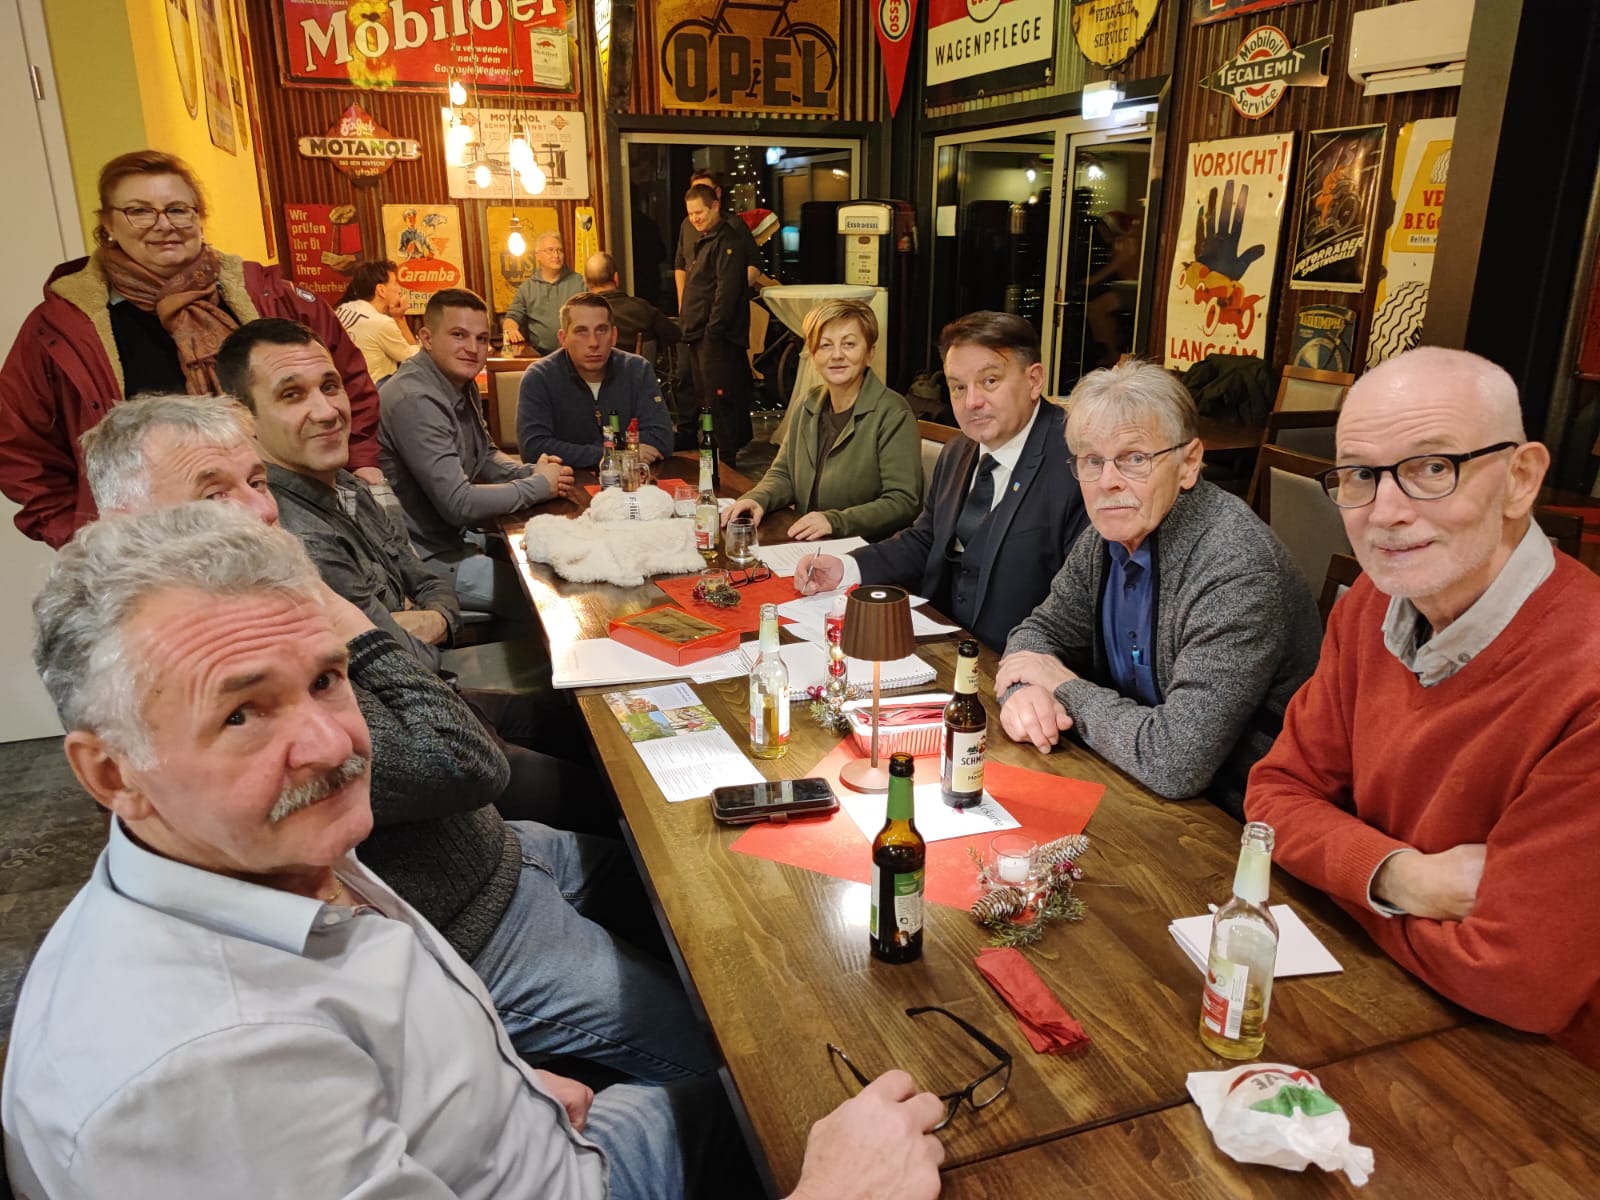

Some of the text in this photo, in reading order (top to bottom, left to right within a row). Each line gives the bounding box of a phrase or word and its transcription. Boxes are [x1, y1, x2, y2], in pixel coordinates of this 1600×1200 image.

[1095, 2, 1134, 22] VERKAUF
[935, 16, 1041, 66] WAGENPFLEGE
[1094, 27, 1129, 48] SERVICE
[1239, 30, 1285, 62] Mobiloil
[482, 55, 500, 63] dem
[674, 33, 828, 107] OPEL
[1217, 51, 1305, 87] TECALEMIT
[1236, 88, 1278, 114] Service
[310, 139, 415, 157] MOTANOL
[1193, 141, 1288, 182] VORSICHT!
[289, 209, 307, 220] Wir
[292, 223, 326, 235] prüfen
[294, 237, 320, 250] Ihr Öl
[296, 254, 307, 262] zu
[297, 266, 321, 276] Ihrer
[398, 266, 455, 282] Caramba
